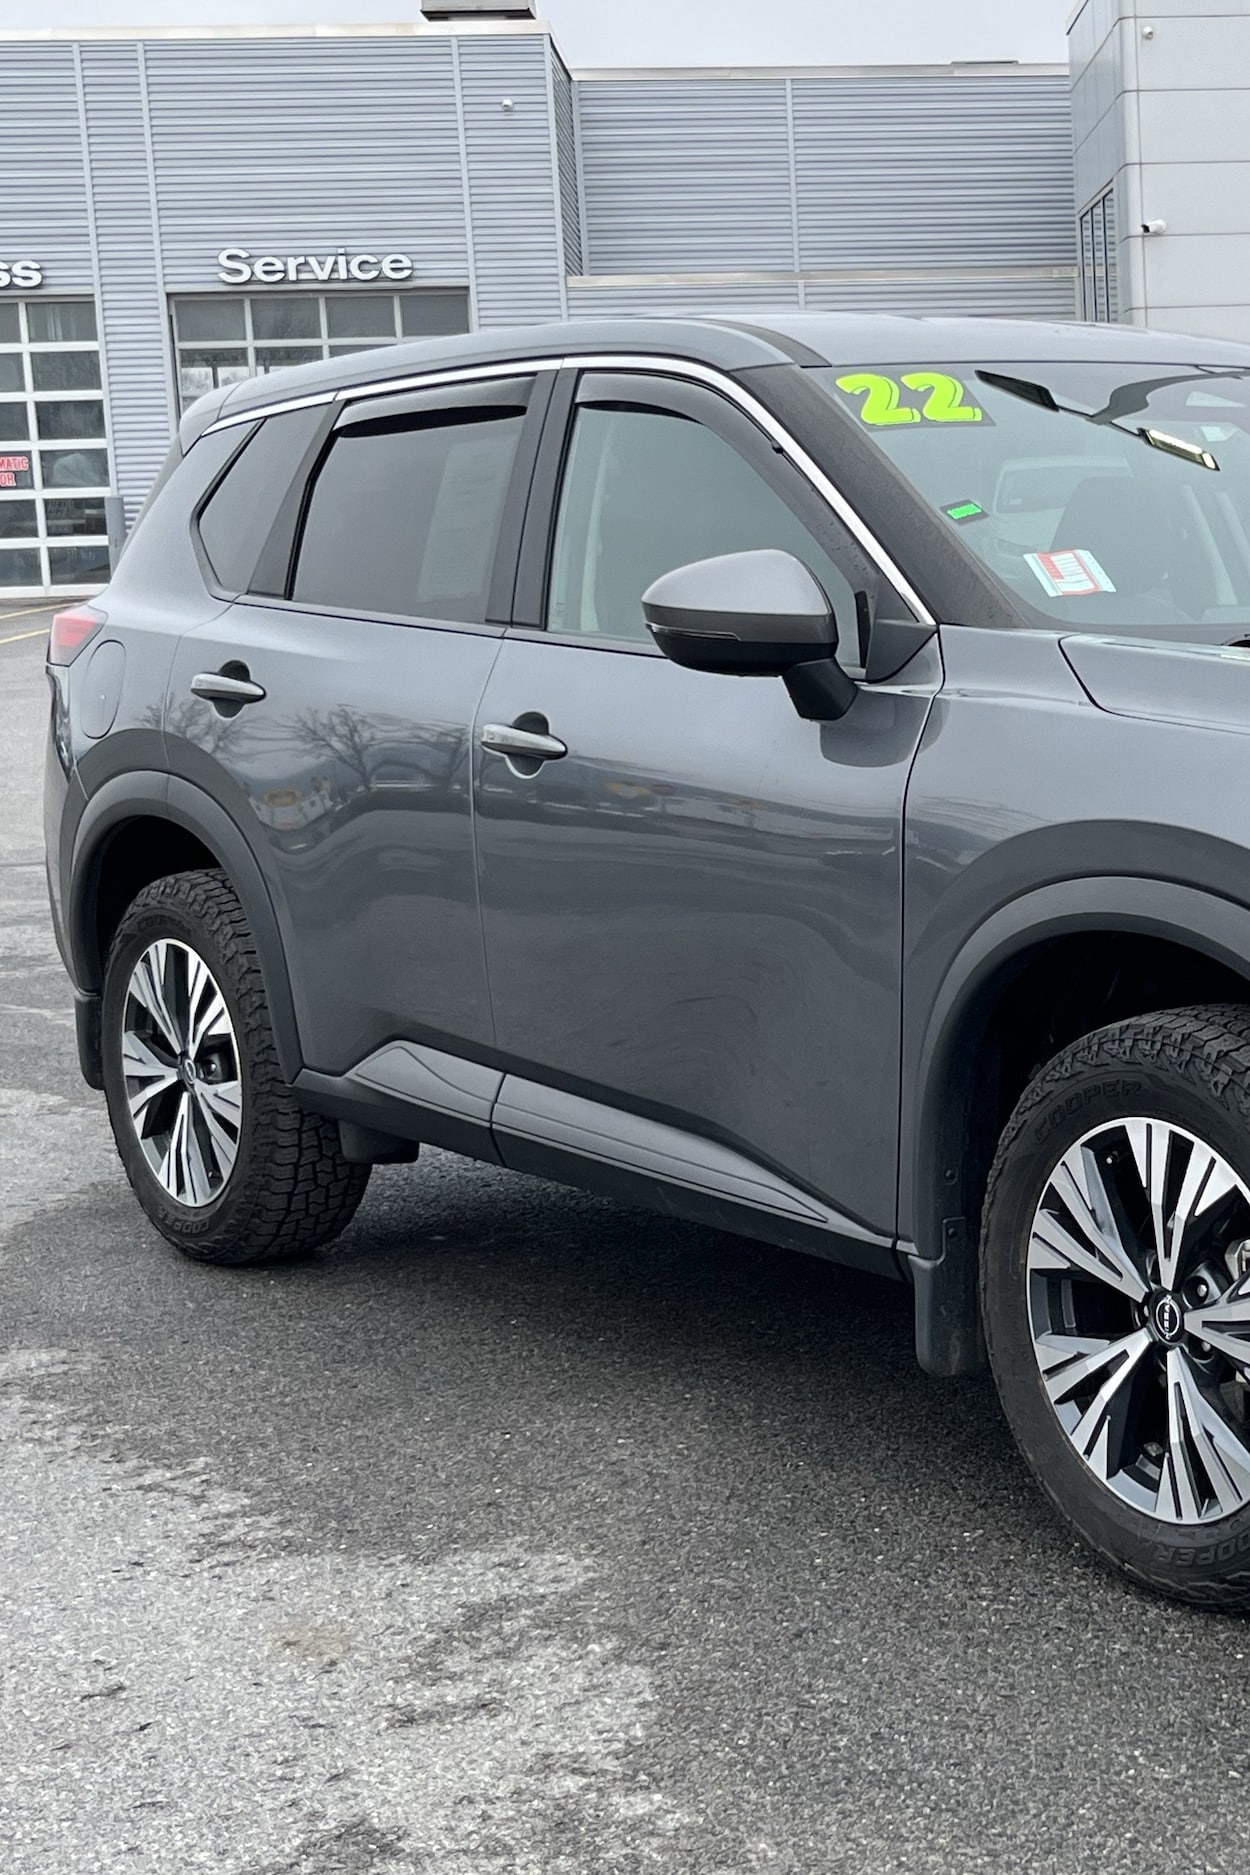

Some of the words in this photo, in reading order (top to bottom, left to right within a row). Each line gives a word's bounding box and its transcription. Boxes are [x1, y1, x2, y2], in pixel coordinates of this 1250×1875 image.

[217, 247, 414, 284] Service
[835, 372, 983, 425] 22
[1034, 1079, 1142, 1144] COOPER
